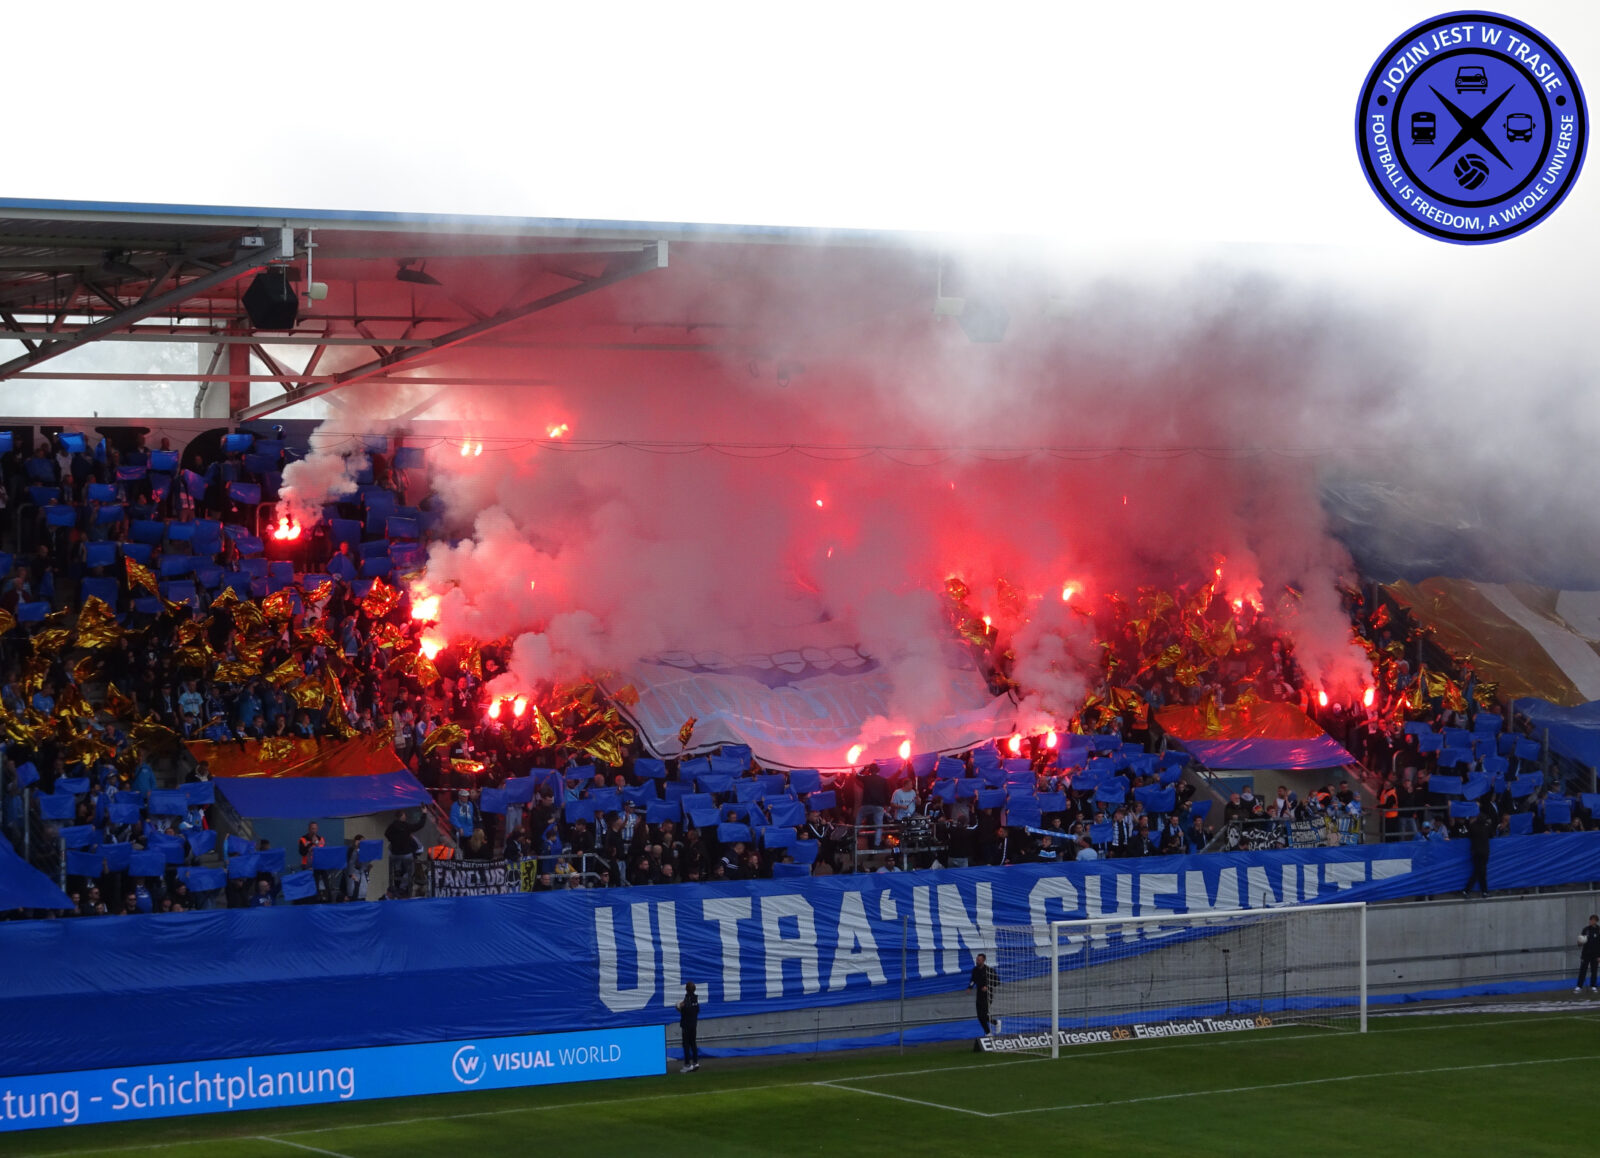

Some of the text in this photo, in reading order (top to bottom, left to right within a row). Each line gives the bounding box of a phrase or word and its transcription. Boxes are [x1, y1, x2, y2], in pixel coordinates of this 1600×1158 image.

[434, 868, 505, 888] FANCLUB
[1134, 1021, 1204, 1039] Eisenbach
[980, 1033, 1053, 1051] Eisenbach
[492, 1044, 621, 1071] VISUAL WORLD
[0, 1090, 79, 1123] tung
[112, 1066, 355, 1110] Schichtplanung
